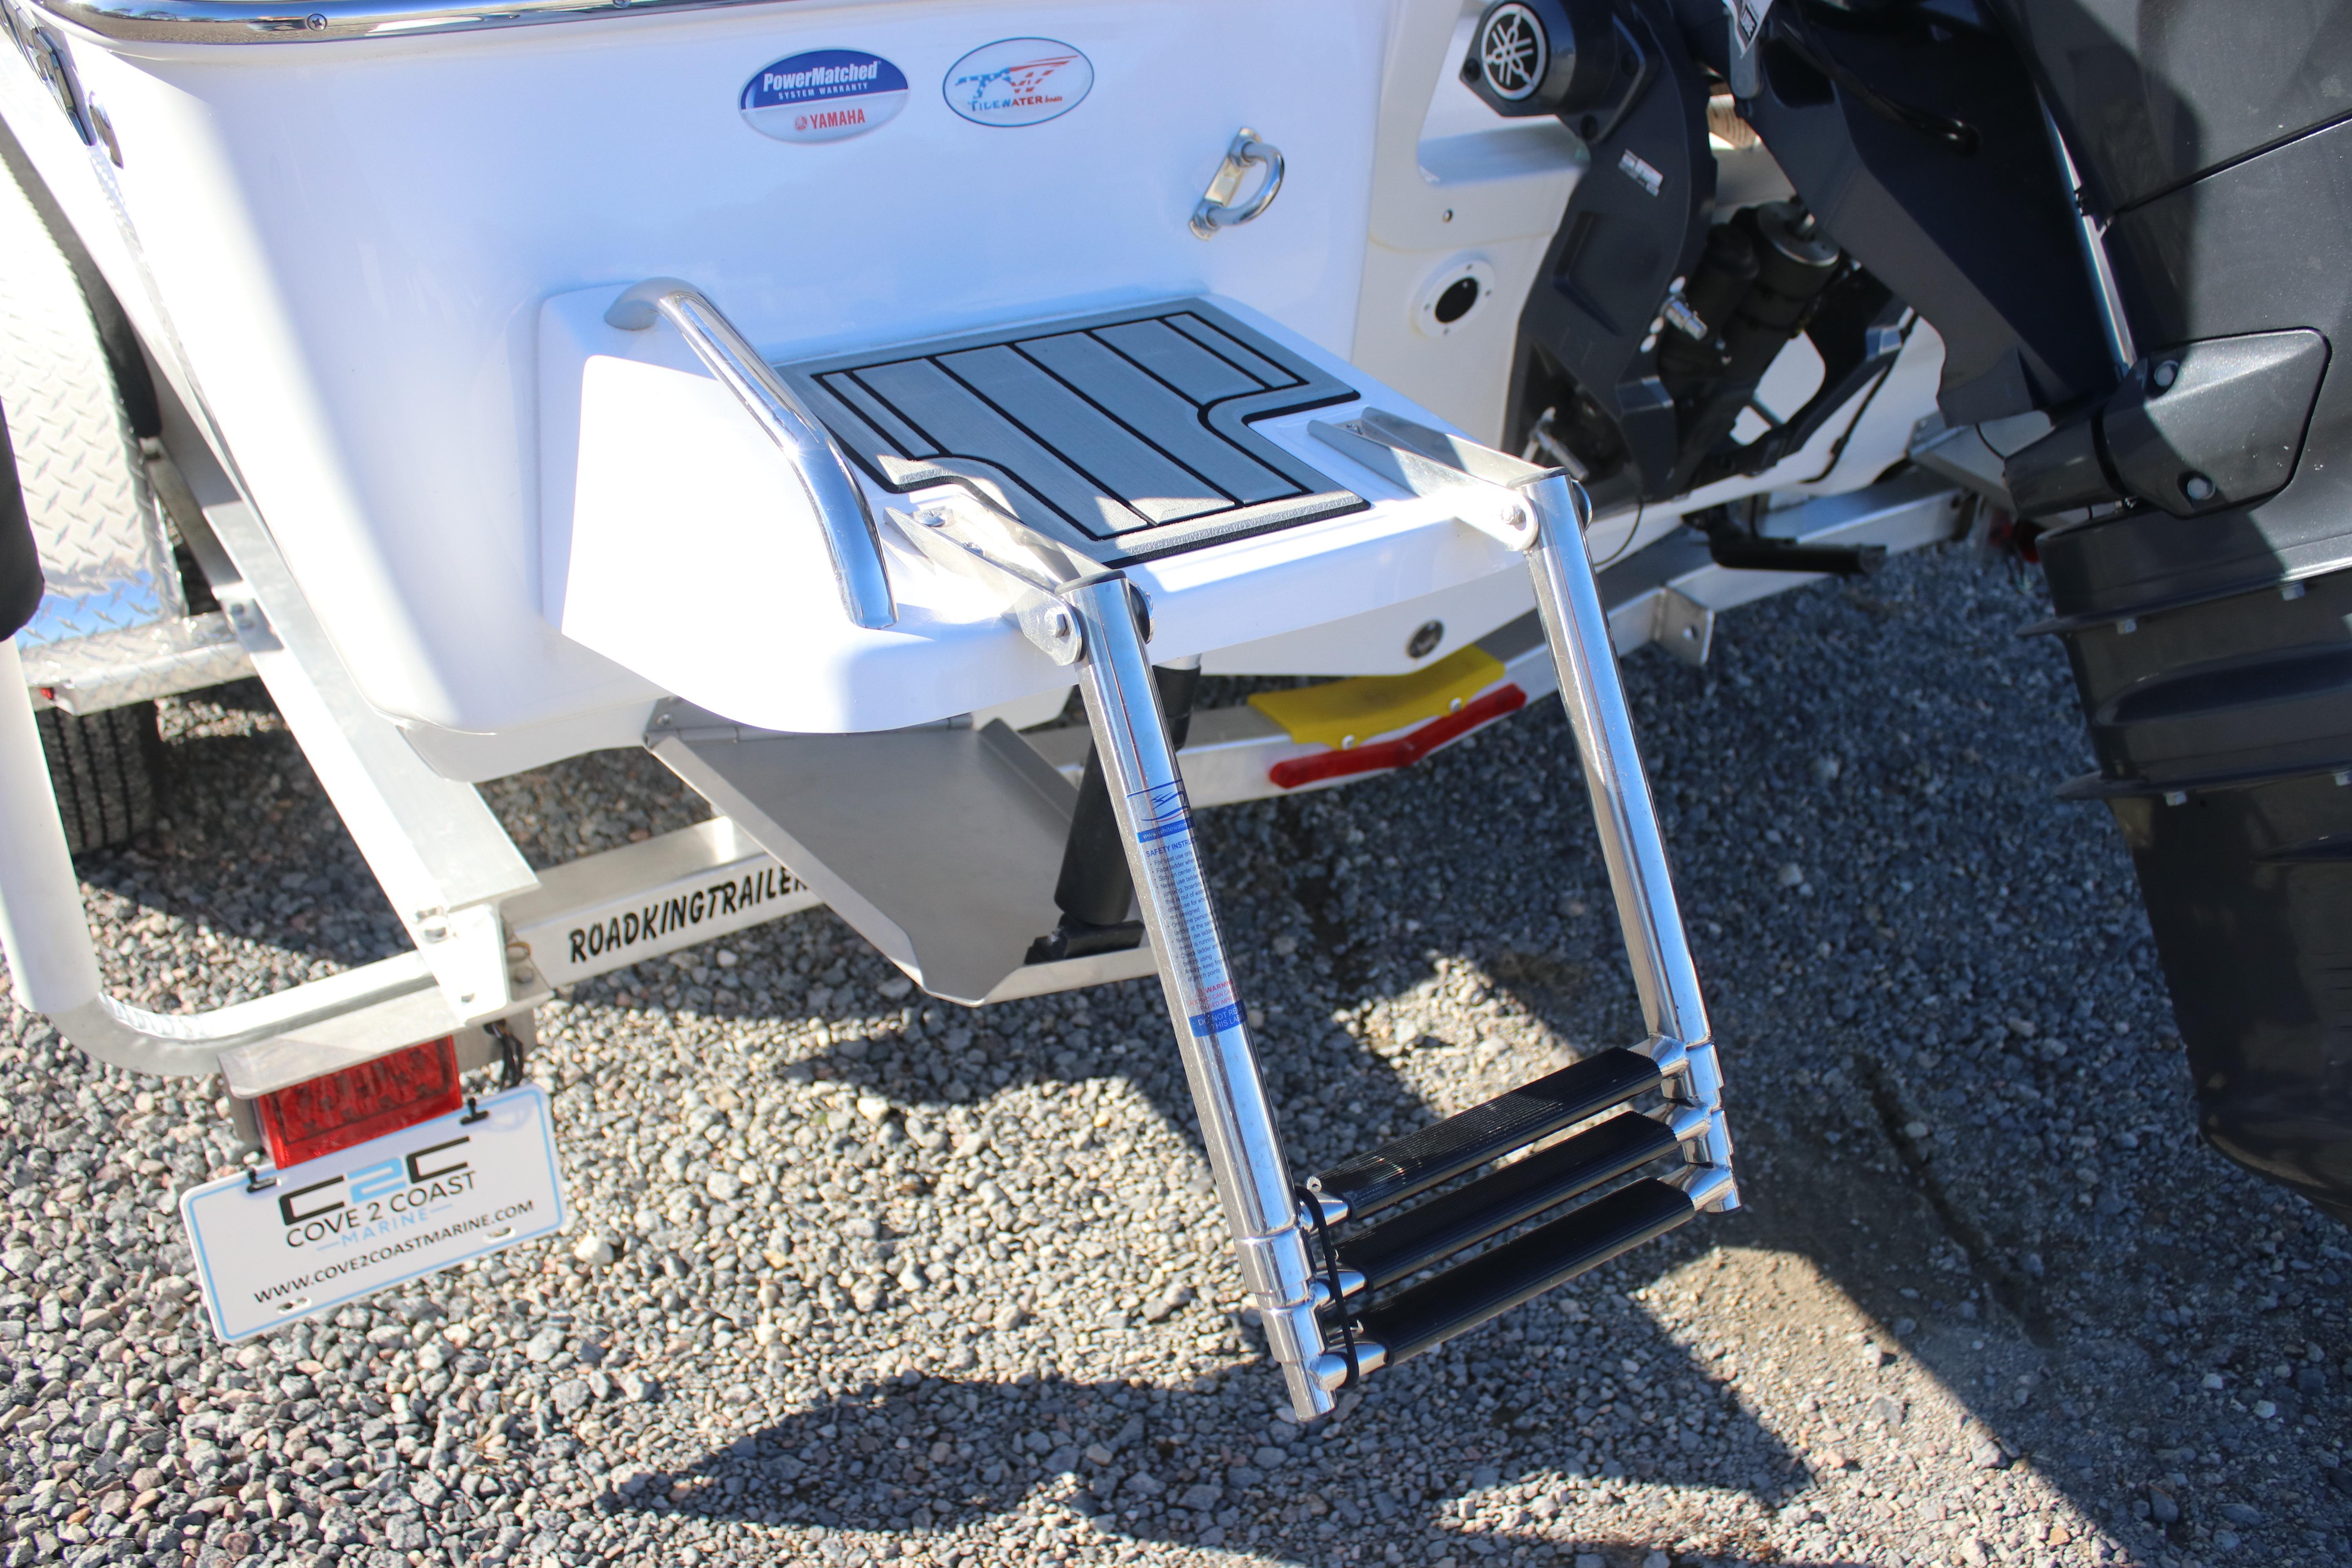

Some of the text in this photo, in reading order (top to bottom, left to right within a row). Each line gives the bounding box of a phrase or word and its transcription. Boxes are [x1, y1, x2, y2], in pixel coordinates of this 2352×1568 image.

[764, 61, 877, 92] PowerMatched
[779, 82, 868, 100] SYSTEM WARRANTY
[809, 109, 866, 129] YAMAHA
[1146, 845, 1171, 857] SAFETY
[1169, 861, 1185, 870] ladder
[1158, 874, 1170, 882] Stay
[1185, 882, 1202, 891] boarding
[1179, 907, 1200, 918] designed
[1194, 913, 1209, 922] person
[1174, 927, 1189, 935] ladder
[1176, 935, 1191, 943] Never
[1199, 936, 1215, 946] running
[1180, 950, 1196, 959] Check
[1197, 946, 1212, 954] ladder
[1183, 954, 1212, 967] before using
[1185, 965, 1202, 975] Always
[1193, 973, 1207, 981] pinch
[1208, 968, 1221, 977] points
[1205, 979, 1233, 993] WARNING
[1204, 1001, 1220, 1010] USED
[1198, 1017, 1209, 1025] DO
[1212, 1012, 1227, 1022] NOT
[1212, 1020, 1228, 1030] THIS
[279, 1136, 470, 1225] C2C
[287, 1171, 477, 1248] COVE 2 COAST
[341, 1208, 429, 1247] MARINE
[254, 1200, 534, 1304] WWW.COVE2COASTMARINE.COM
